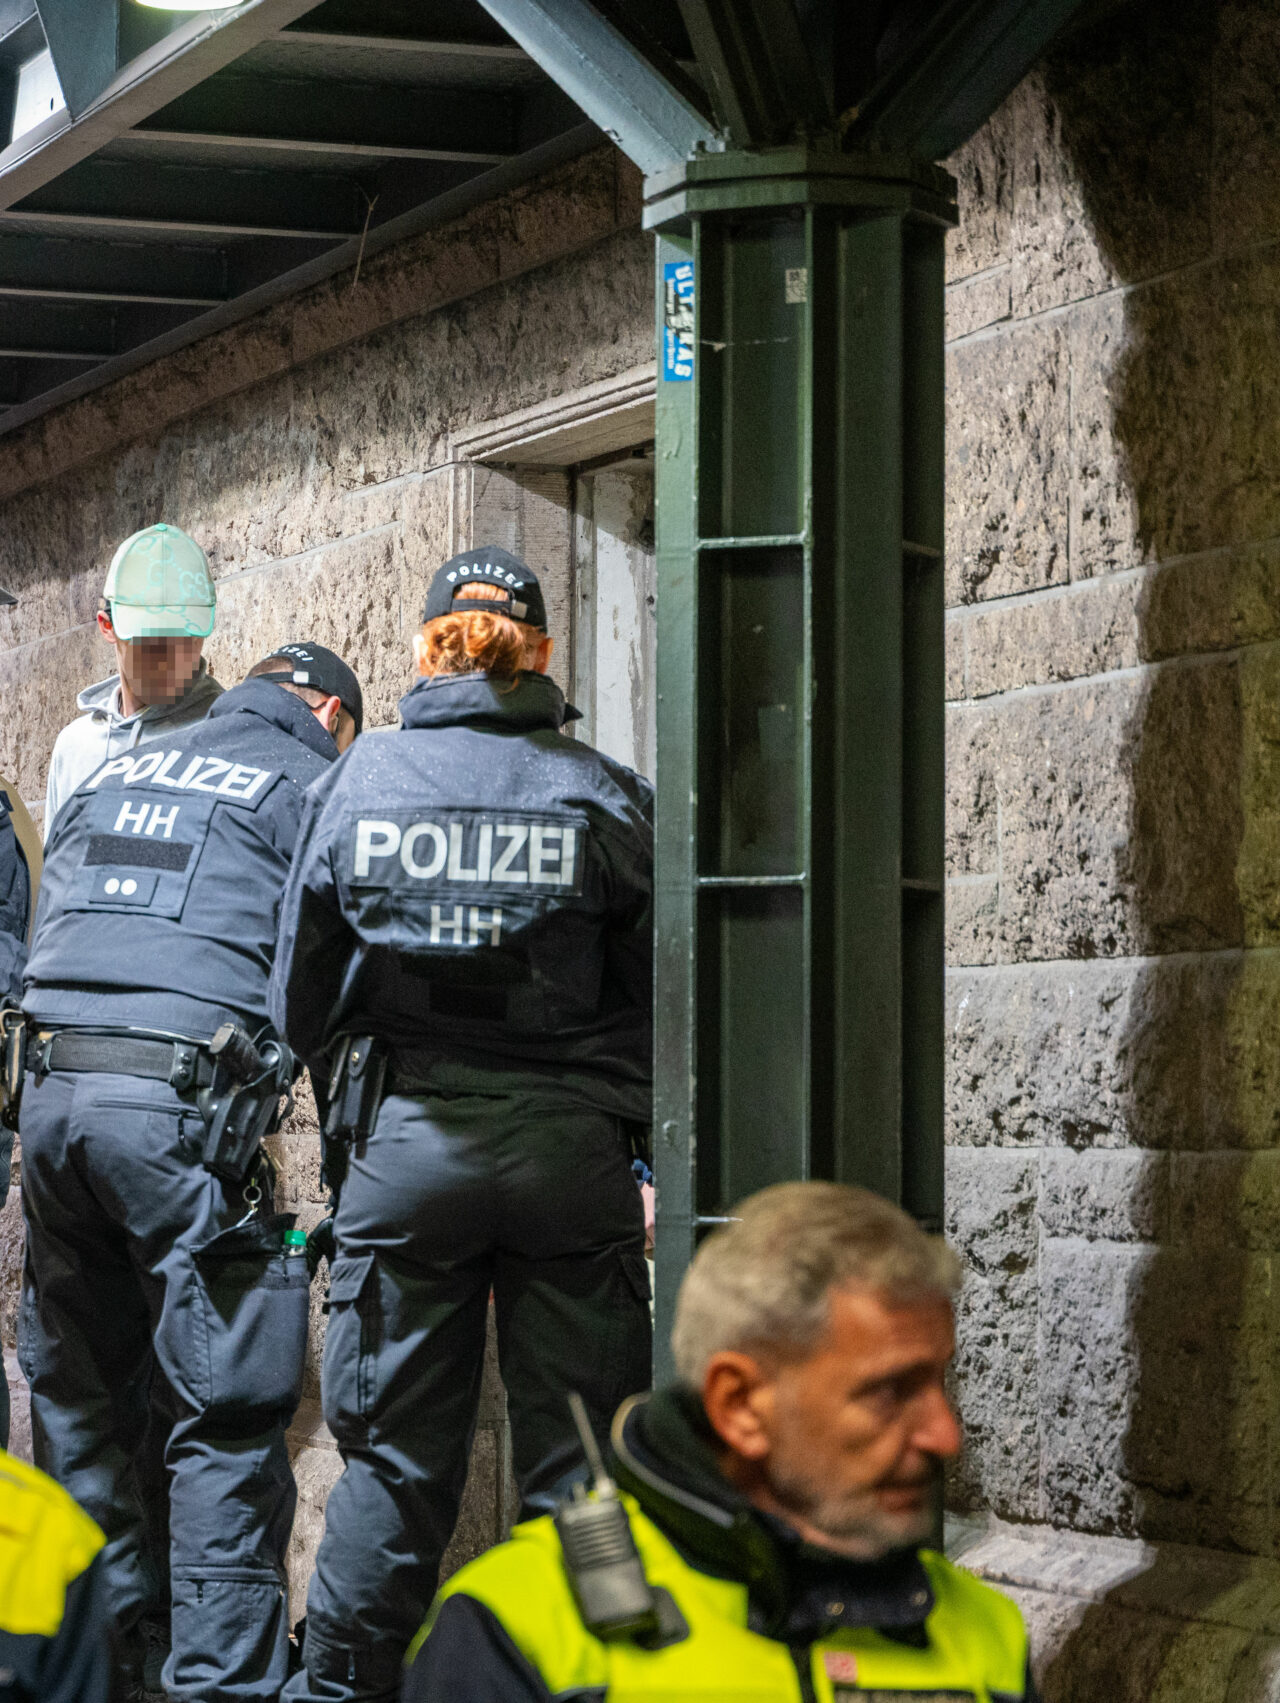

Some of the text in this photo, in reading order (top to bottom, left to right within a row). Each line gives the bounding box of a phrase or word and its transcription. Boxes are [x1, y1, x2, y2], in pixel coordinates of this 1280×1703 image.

[447, 563, 524, 588] POLIZEI
[85, 750, 272, 800] POLIZEI
[113, 800, 180, 838] HH
[354, 819, 576, 886] POLIZEI
[429, 904, 503, 947] HH
